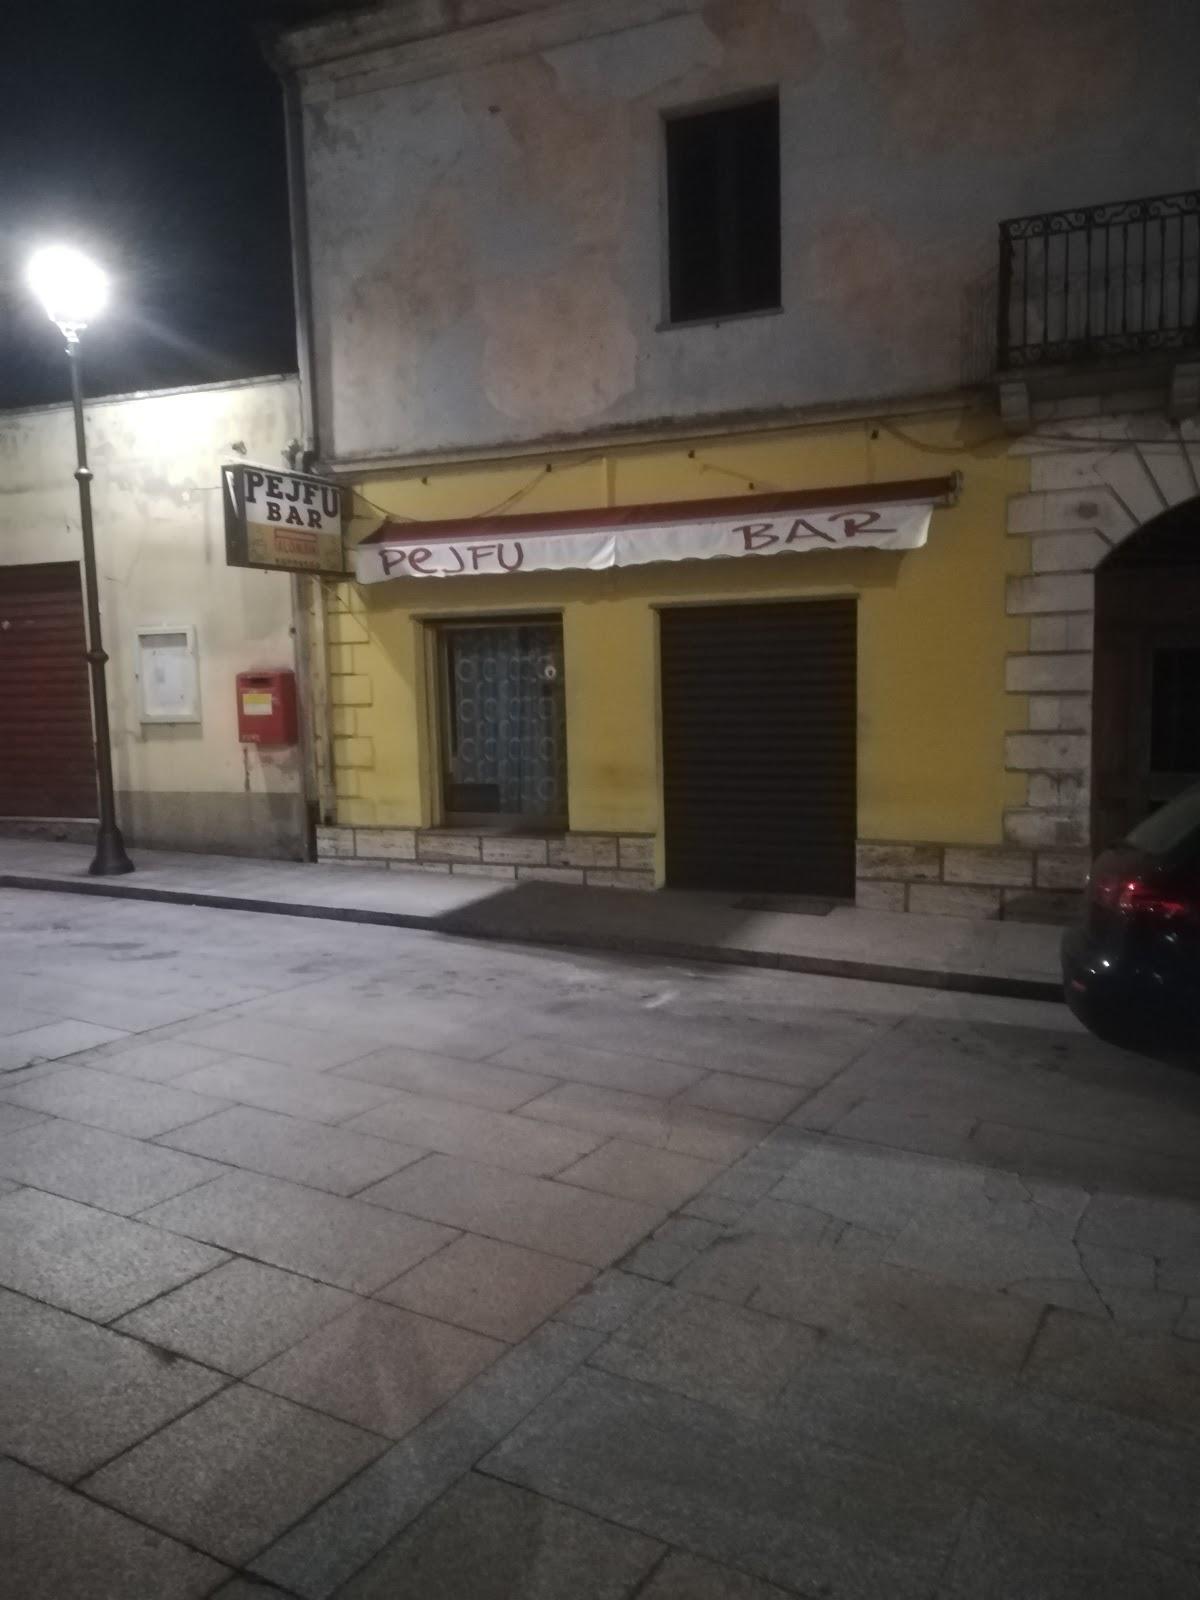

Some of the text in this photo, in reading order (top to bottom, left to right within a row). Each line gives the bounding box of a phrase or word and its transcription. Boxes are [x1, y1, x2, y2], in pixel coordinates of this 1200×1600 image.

[245, 471, 338, 518] PEJFU
[266, 501, 323, 529] BAR
[732, 510, 897, 550] BAR
